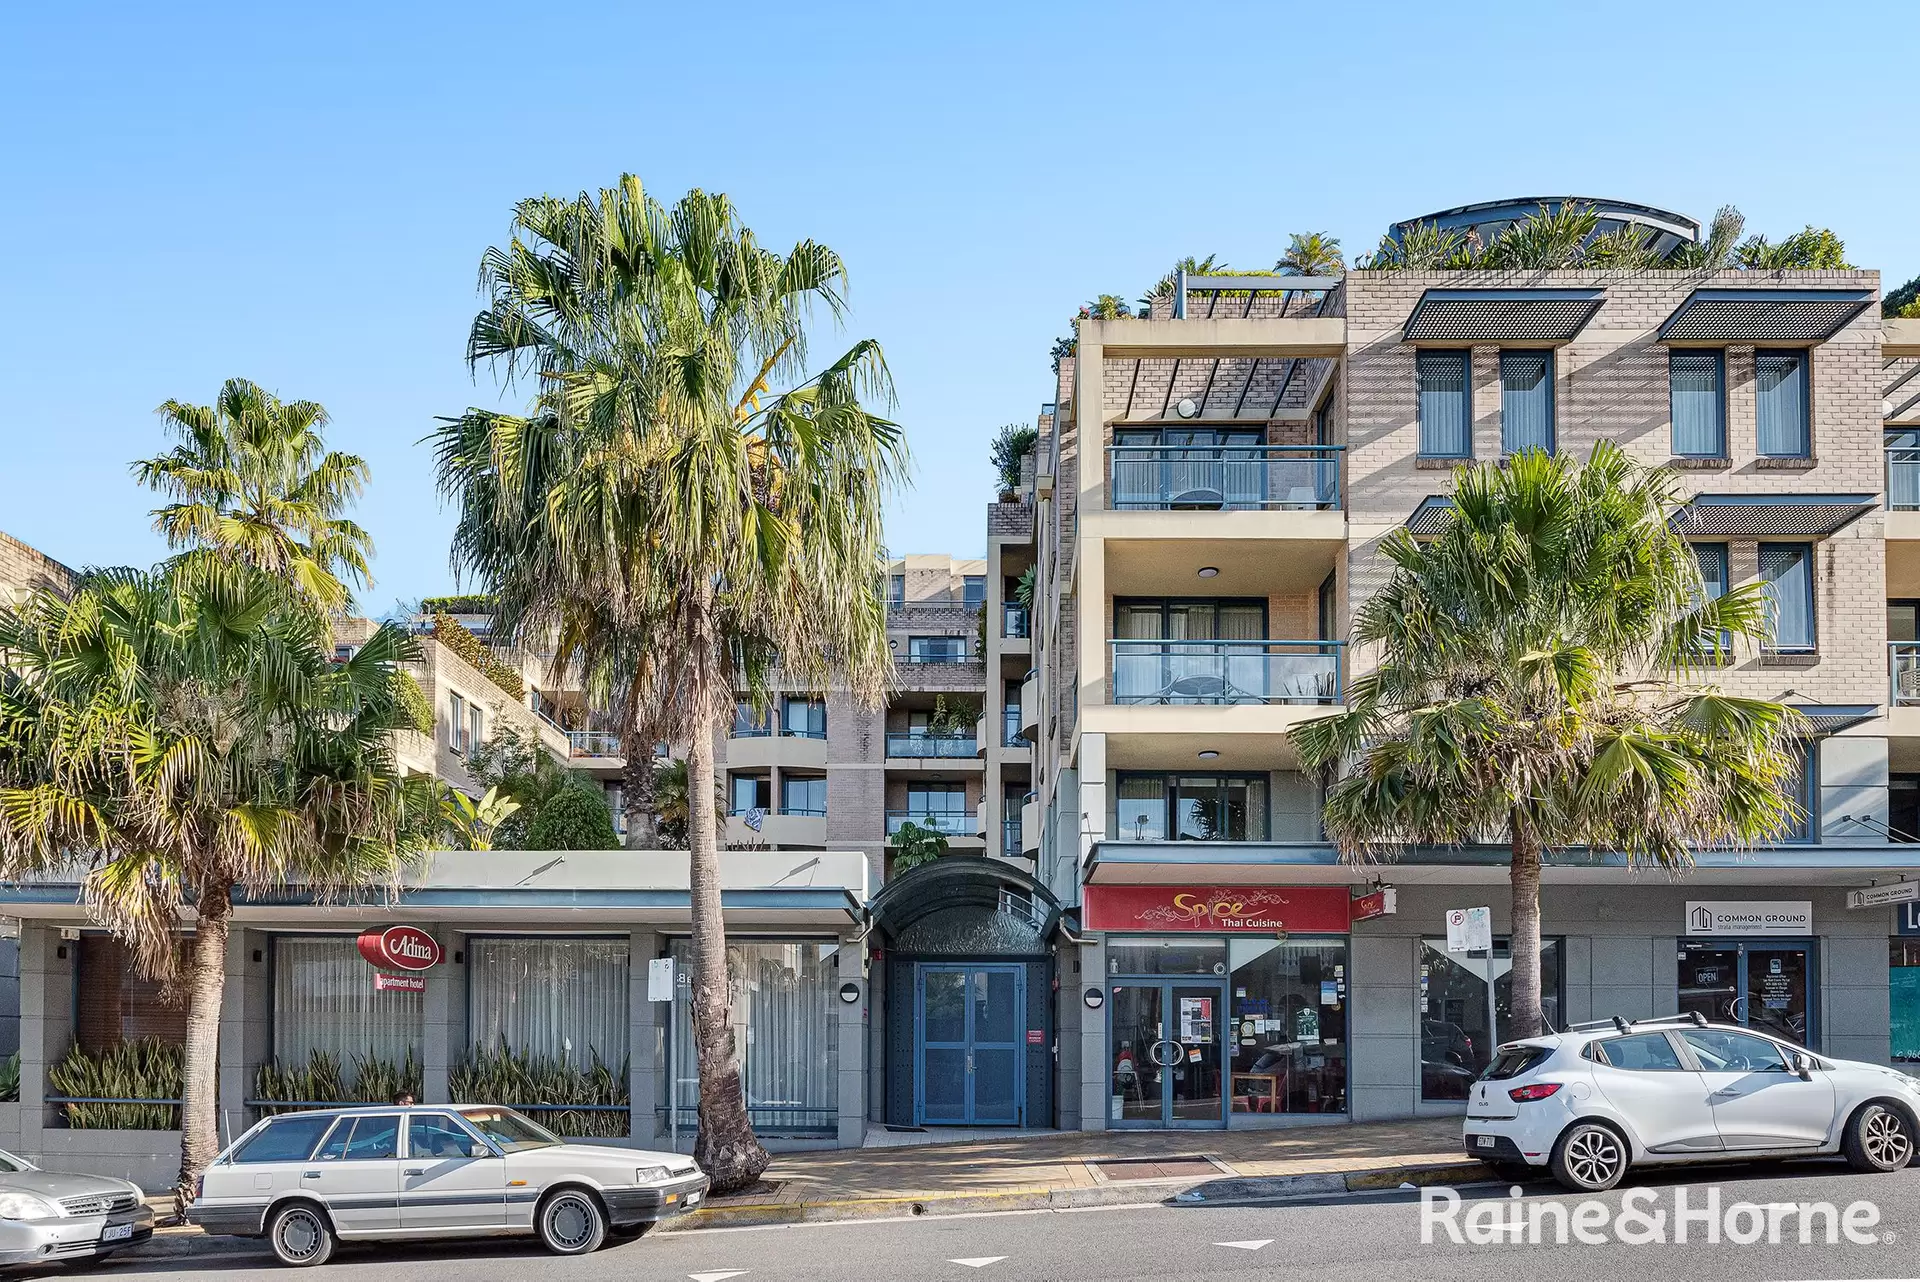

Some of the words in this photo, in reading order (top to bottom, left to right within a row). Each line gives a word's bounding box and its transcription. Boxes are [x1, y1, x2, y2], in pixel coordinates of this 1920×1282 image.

[1866, 891, 1890, 900] COMMON
[1890, 887, 1913, 896] GROUND
[1173, 893, 1257, 928] Spice
[1907, 902, 1920, 929] L
[1221, 918, 1243, 928] Thai
[1246, 918, 1283, 928] Cuisine
[1717, 914, 1762, 923] COMMON
[1765, 914, 1807, 923] GROUND
[390, 935, 432, 960] Adina
[379, 977, 409, 988] apartment
[409, 977, 424, 989] hotel
[1698, 972, 1717, 983] OPEN
